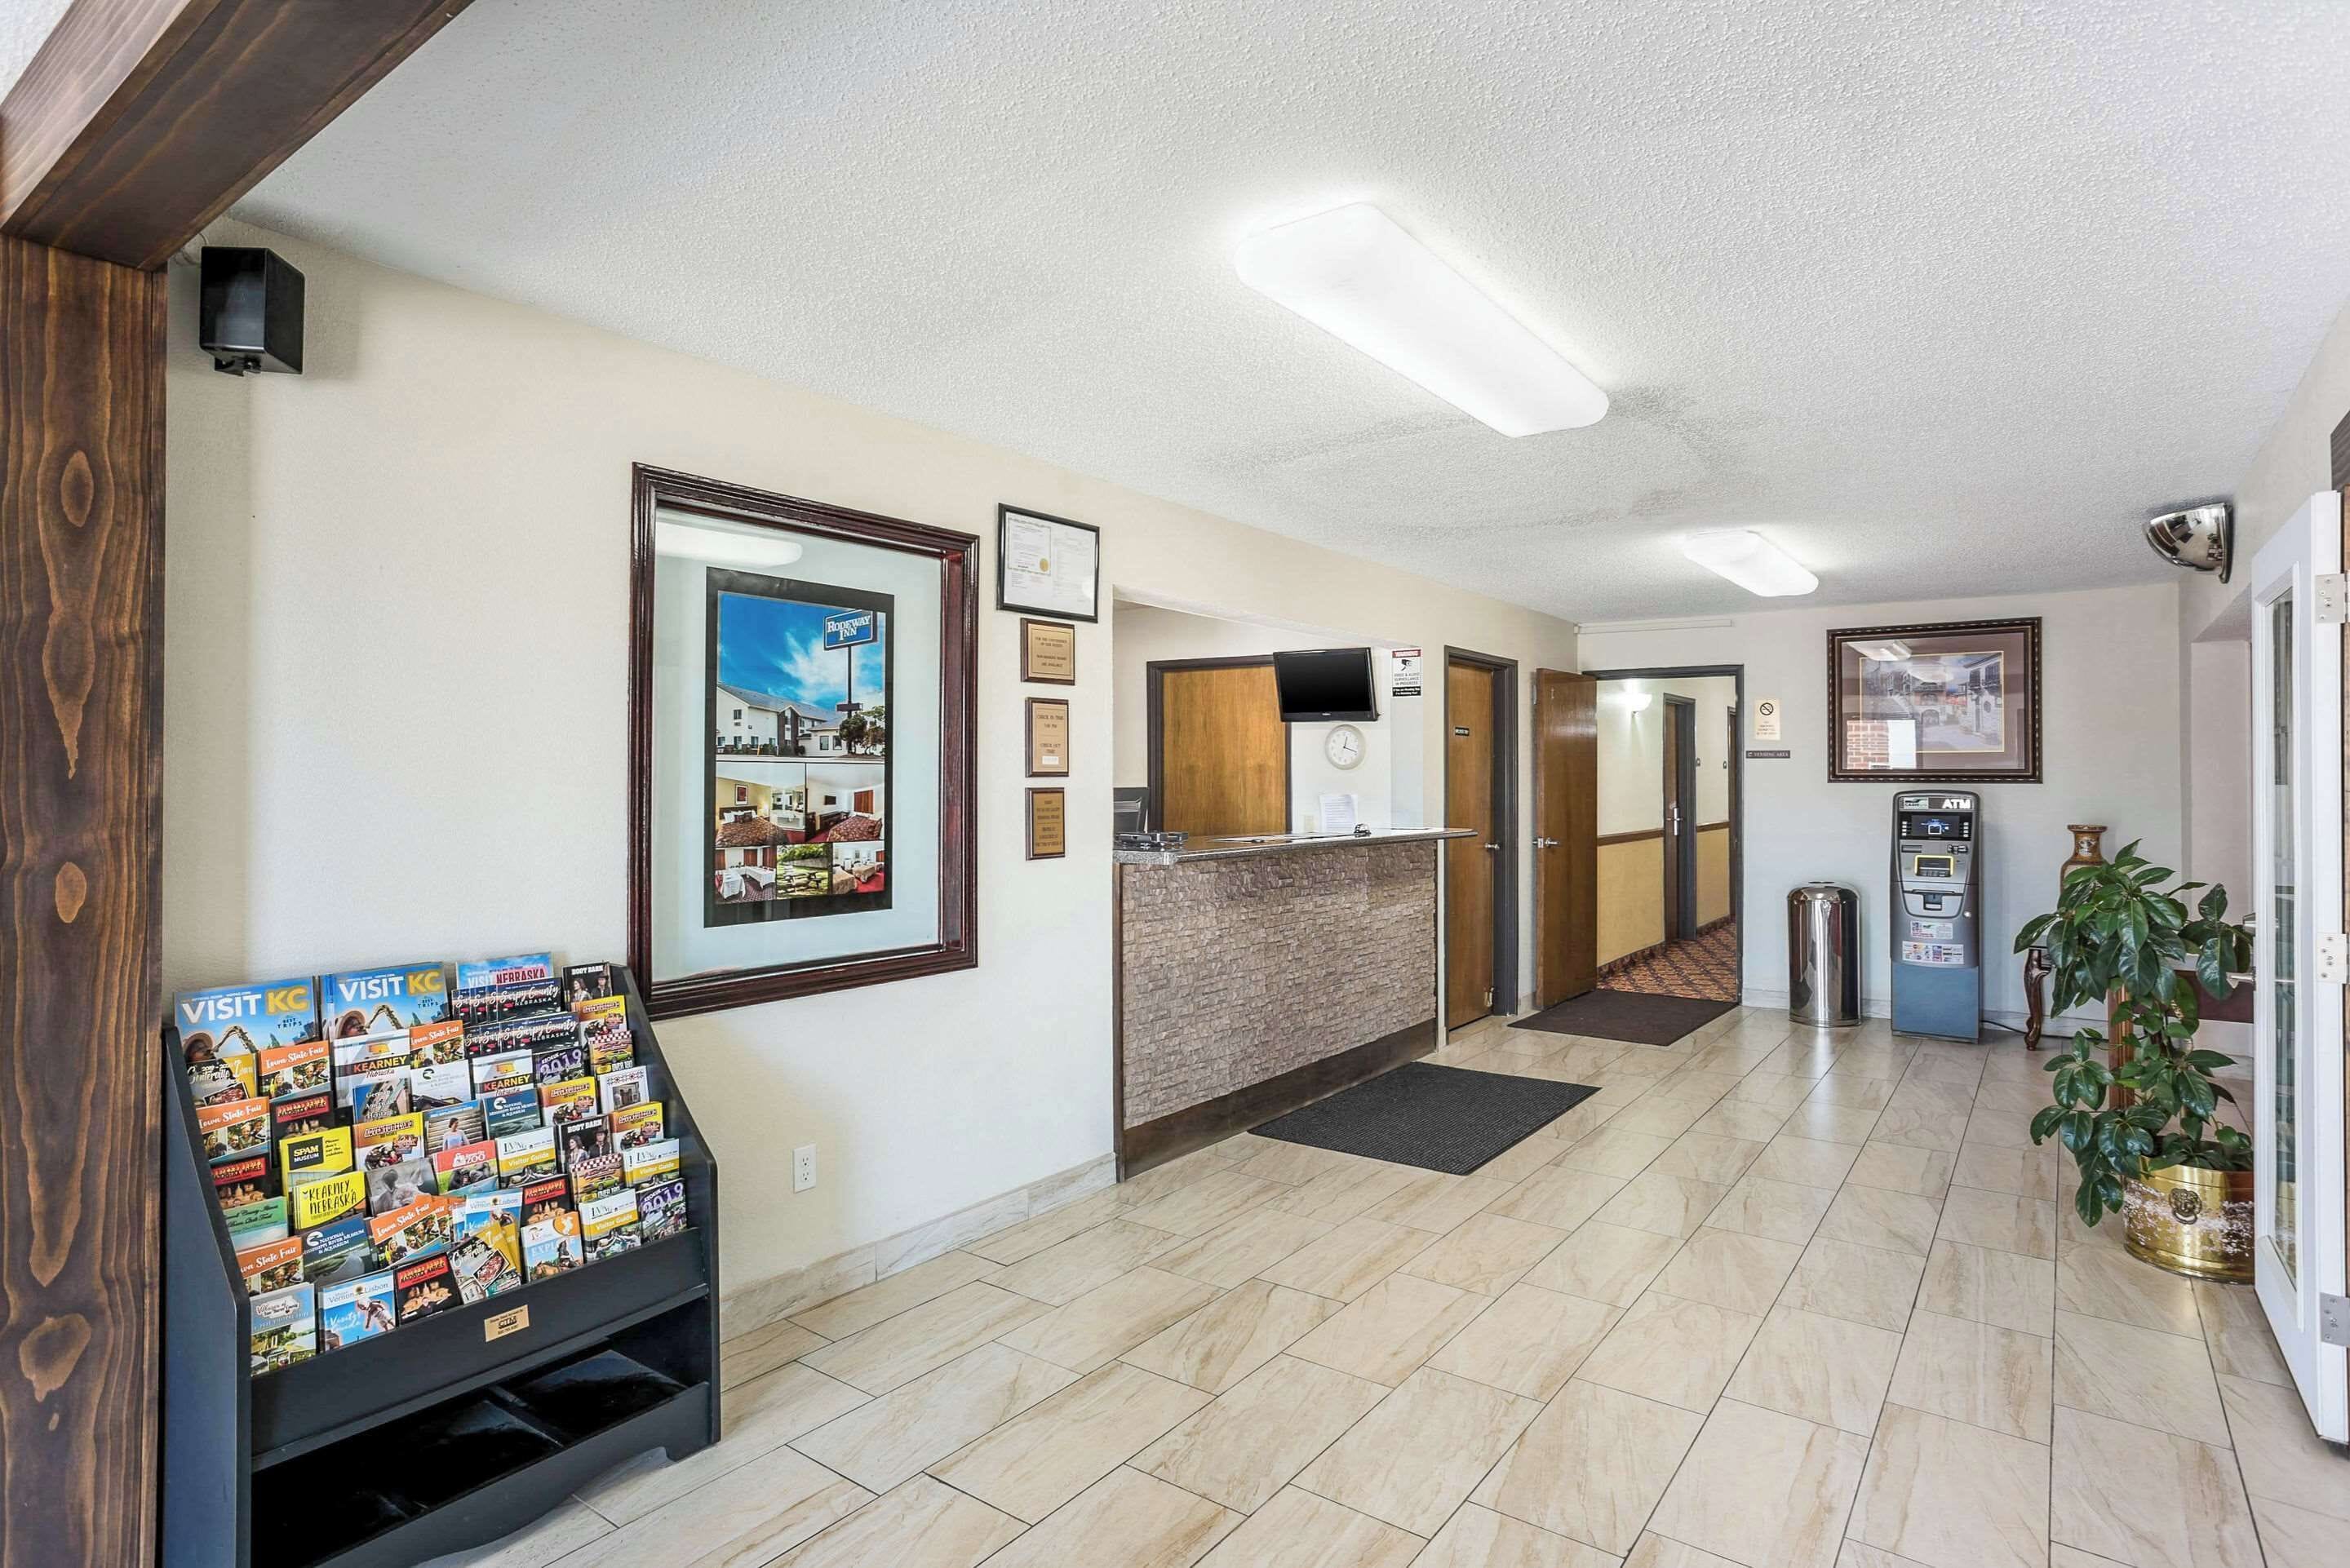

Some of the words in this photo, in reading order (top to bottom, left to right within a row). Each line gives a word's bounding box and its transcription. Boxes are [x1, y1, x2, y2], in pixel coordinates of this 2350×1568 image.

[827, 615, 871, 633] RODEWAY
[839, 627, 857, 640] INN
[1942, 799, 1971, 809] ATM
[338, 977, 404, 1002] VISIT
[408, 971, 441, 994] KC
[529, 984, 560, 999] County
[181, 994, 262, 1024] VISIT
[267, 987, 308, 1014] KC
[515, 997, 552, 1006] NEBRASKA
[277, 1021, 303, 1029] TRIPS
[546, 1018, 578, 1033] County
[429, 1030, 446, 1040] State
[532, 1032, 570, 1043] NEBRASKA
[287, 1050, 308, 1062] State
[308, 1047, 325, 1056] Fair
[353, 1056, 407, 1074] KEARNEY
[539, 1049, 583, 1076] 2019
[484, 1074, 530, 1091] KEARNEY
[222, 1110, 244, 1123] State
[245, 1104, 262, 1114] Fair
[294, 1145, 319, 1157] SPAM
[294, 1153, 319, 1163] MUSEUM
[509, 1156, 530, 1167] Visitor
[530, 1152, 549, 1162] Guide
[310, 1192, 357, 1215] NEBRASKA
[643, 1182, 684, 1211] 2019
[397, 1211, 415, 1225] State
[415, 1202, 431, 1216] Fair
[320, 1232, 344, 1244] NATIONAL
[328, 1238, 343, 1246] RIVER
[344, 1229, 365, 1239] MUSEUM
[324, 1240, 349, 1253] AQUARIUM
[255, 1252, 278, 1268] State
[279, 1247, 297, 1259] Fair
[364, 1283, 389, 1294] Lisbon
